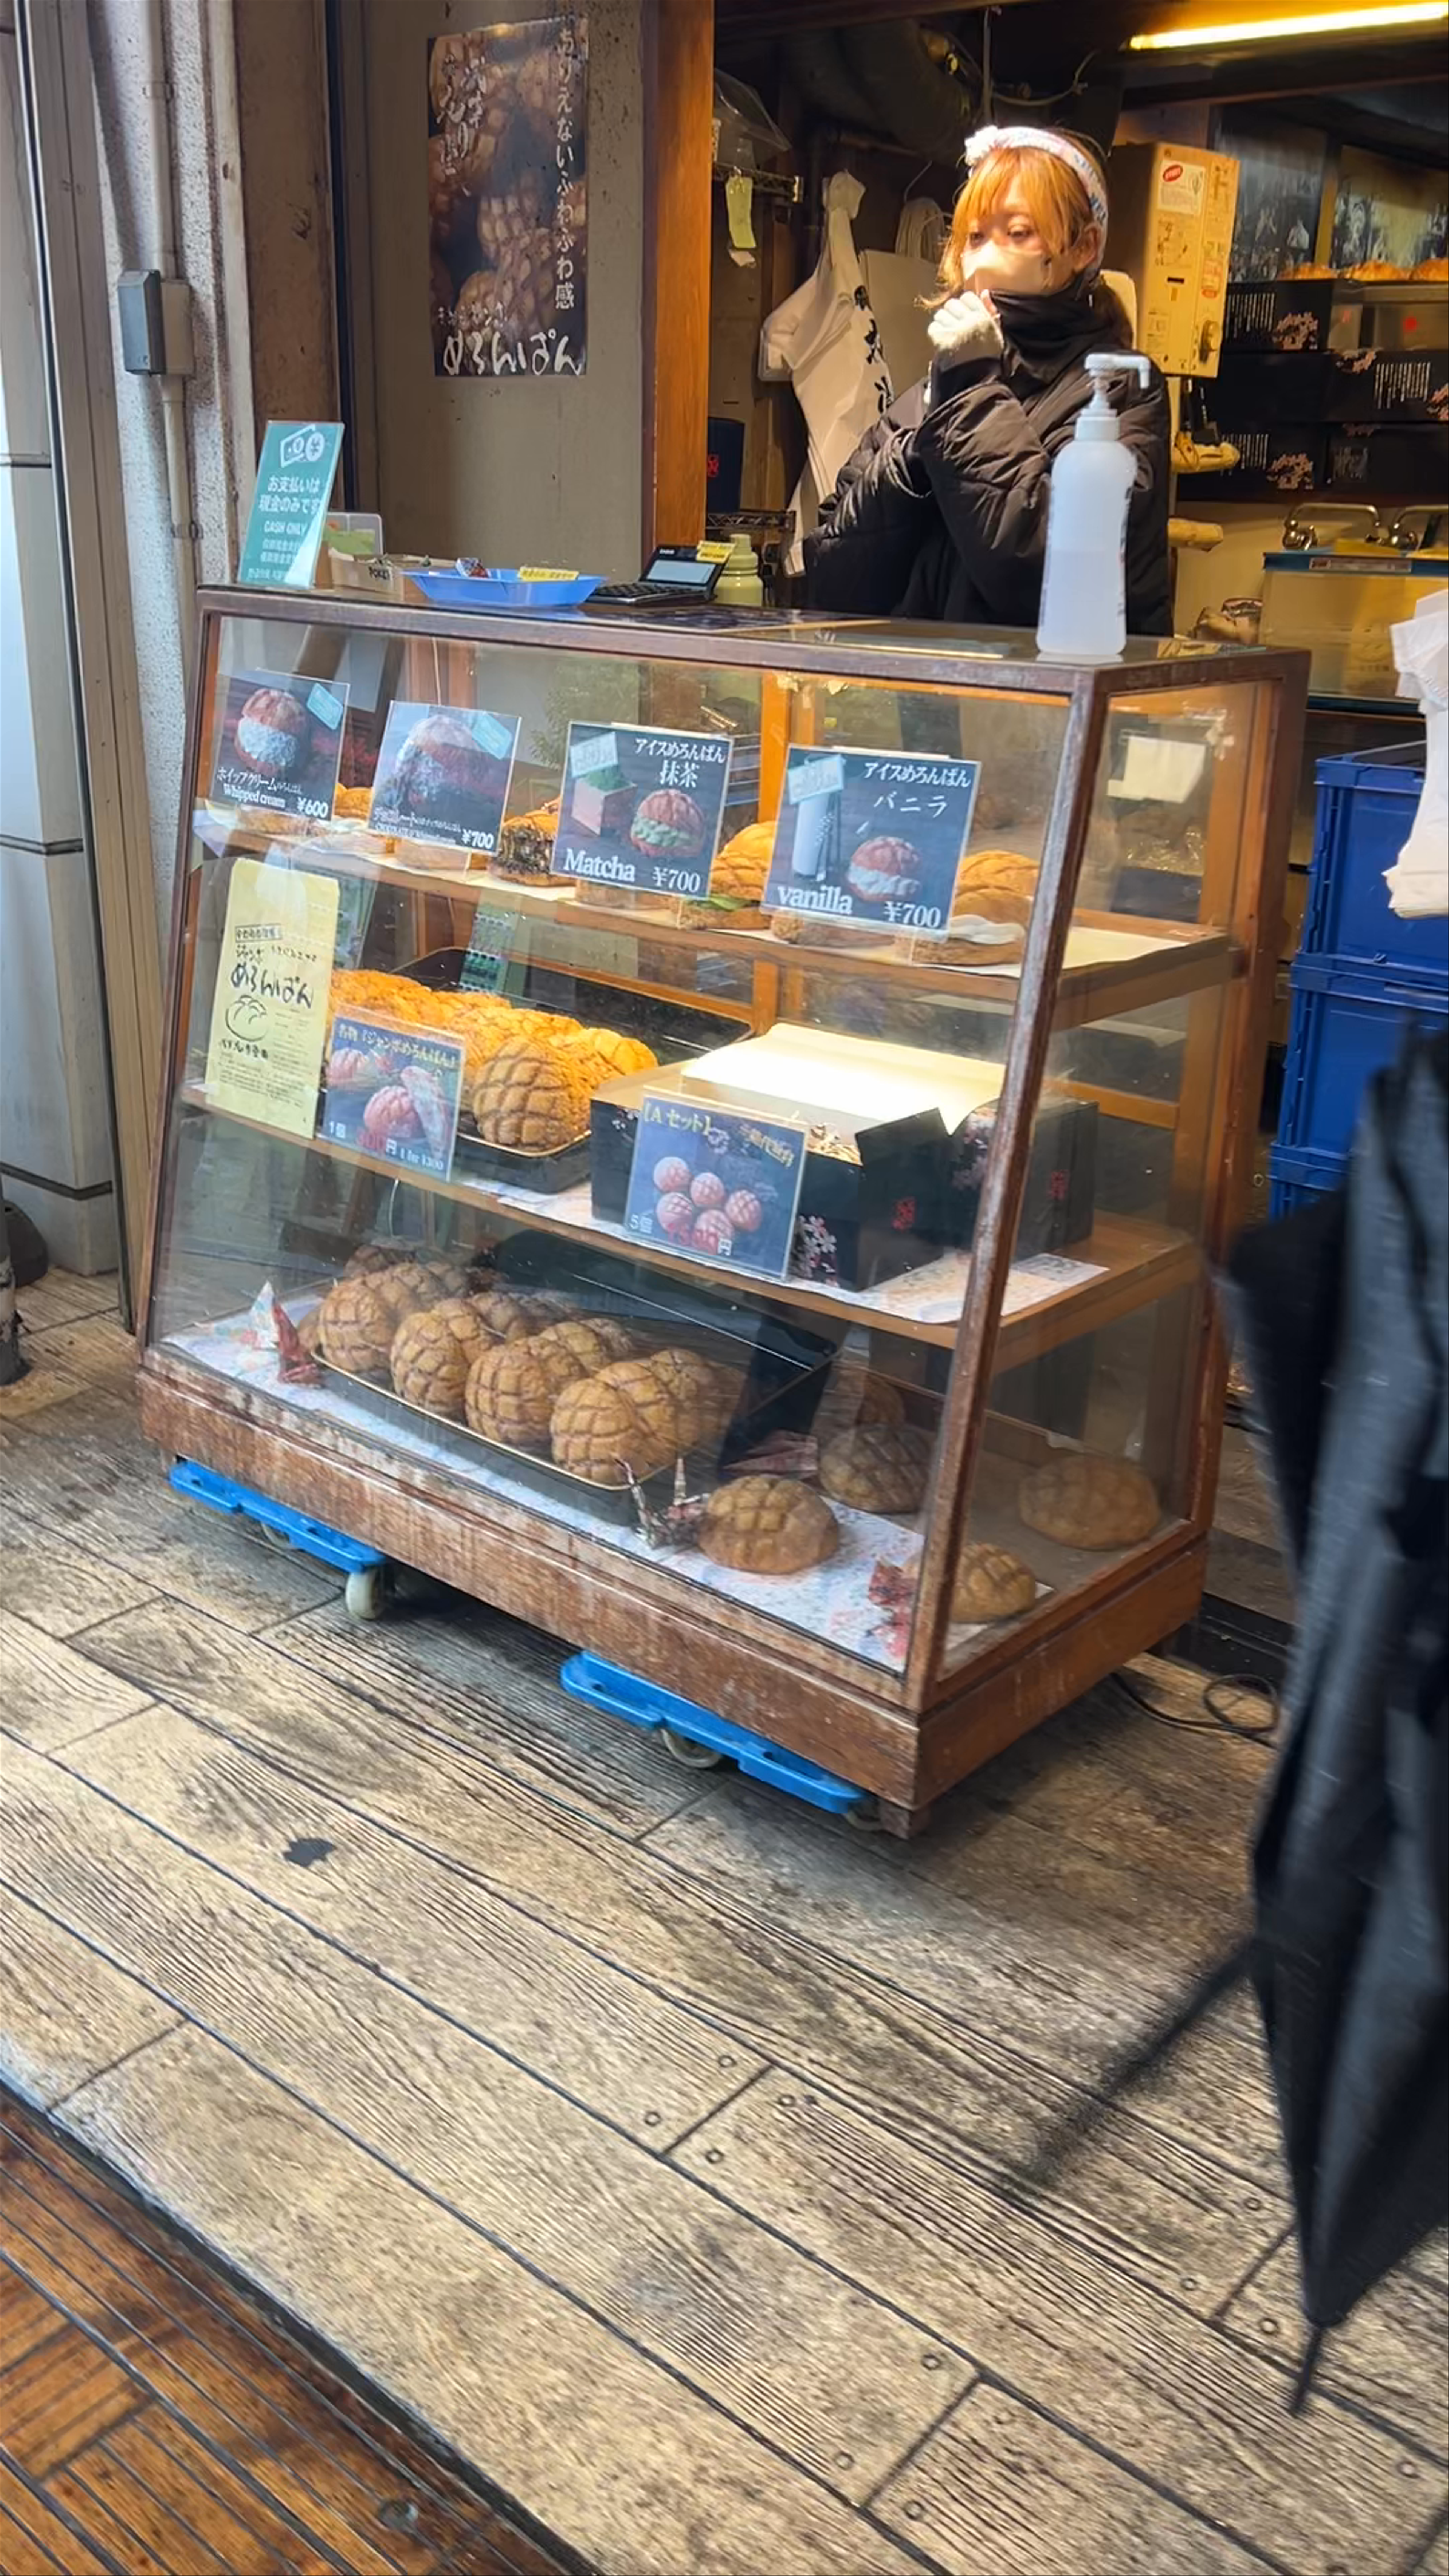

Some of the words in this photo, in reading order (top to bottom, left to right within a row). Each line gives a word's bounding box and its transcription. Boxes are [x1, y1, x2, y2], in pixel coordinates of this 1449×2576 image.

[443, 328, 583, 376] めろんぱん
[267, 475, 320, 493] お支払いは
[258, 494, 321, 515] 現金のみです
[659, 760, 700, 788] 抹茶
[223, 783, 260, 803] Whipped
[873, 791, 947, 818] バニラ
[297, 796, 329, 818] ¥600
[461, 828, 494, 849] ¥700
[563, 847, 636, 883] Matcha
[652, 866, 701, 893] ¥700
[777, 885, 853, 915] vanilla
[883, 900, 942, 929] ¥700
[230, 961, 314, 1009] めろんぱん
